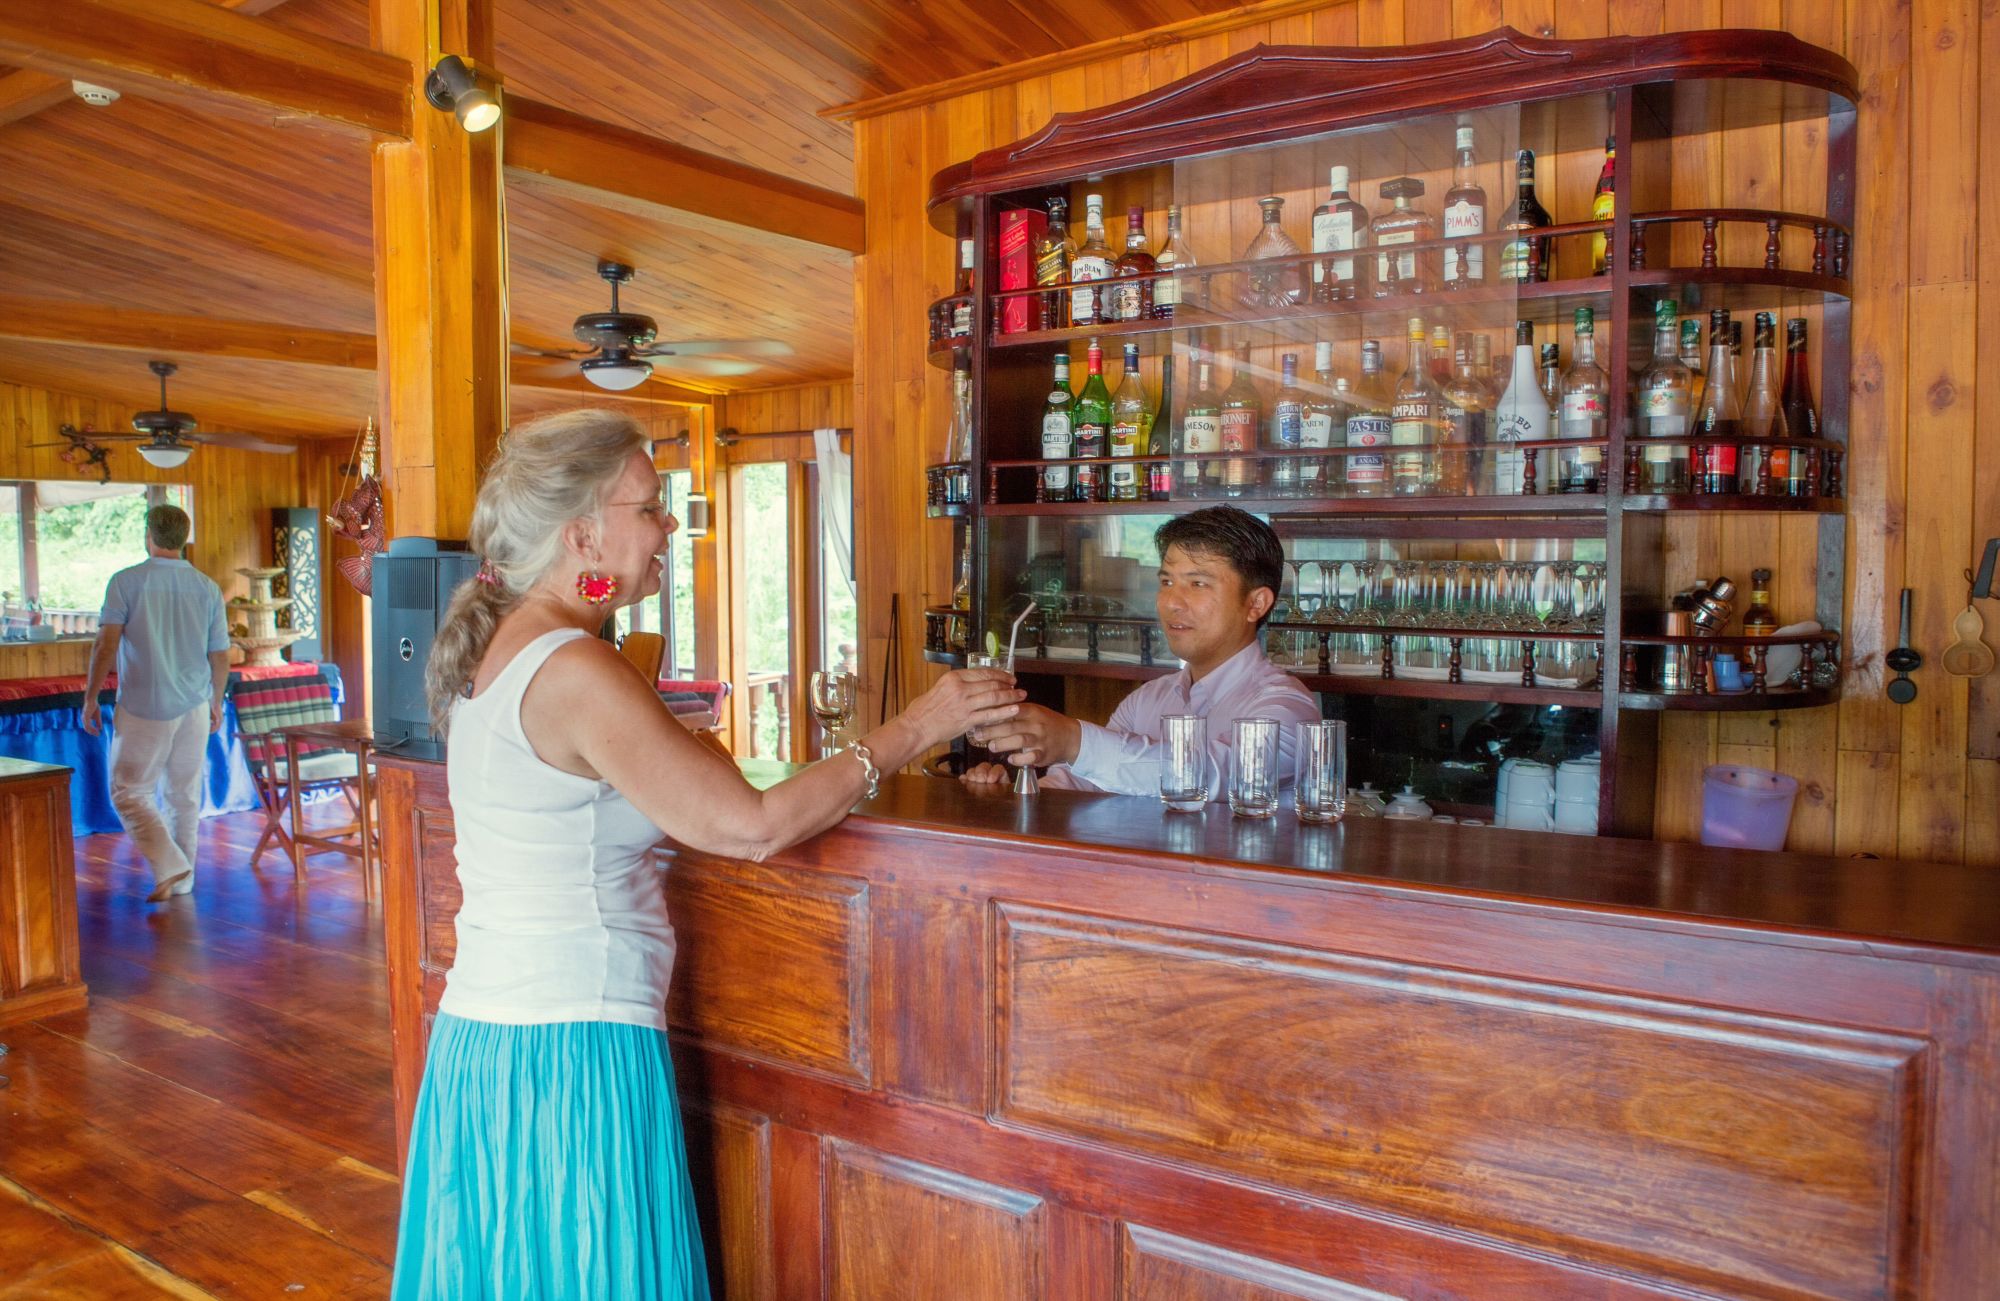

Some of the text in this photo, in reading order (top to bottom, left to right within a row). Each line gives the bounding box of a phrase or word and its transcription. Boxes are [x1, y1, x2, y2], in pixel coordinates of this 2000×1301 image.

[1446, 212, 1480, 229] PIMM'S
[1073, 263, 1102, 279] JIM BEAM
[1276, 405, 1299, 415] SMIRN
[1392, 404, 1428, 417] AMPARI
[1184, 420, 1216, 432] AMESON
[1350, 420, 1391, 433] PASTIS
